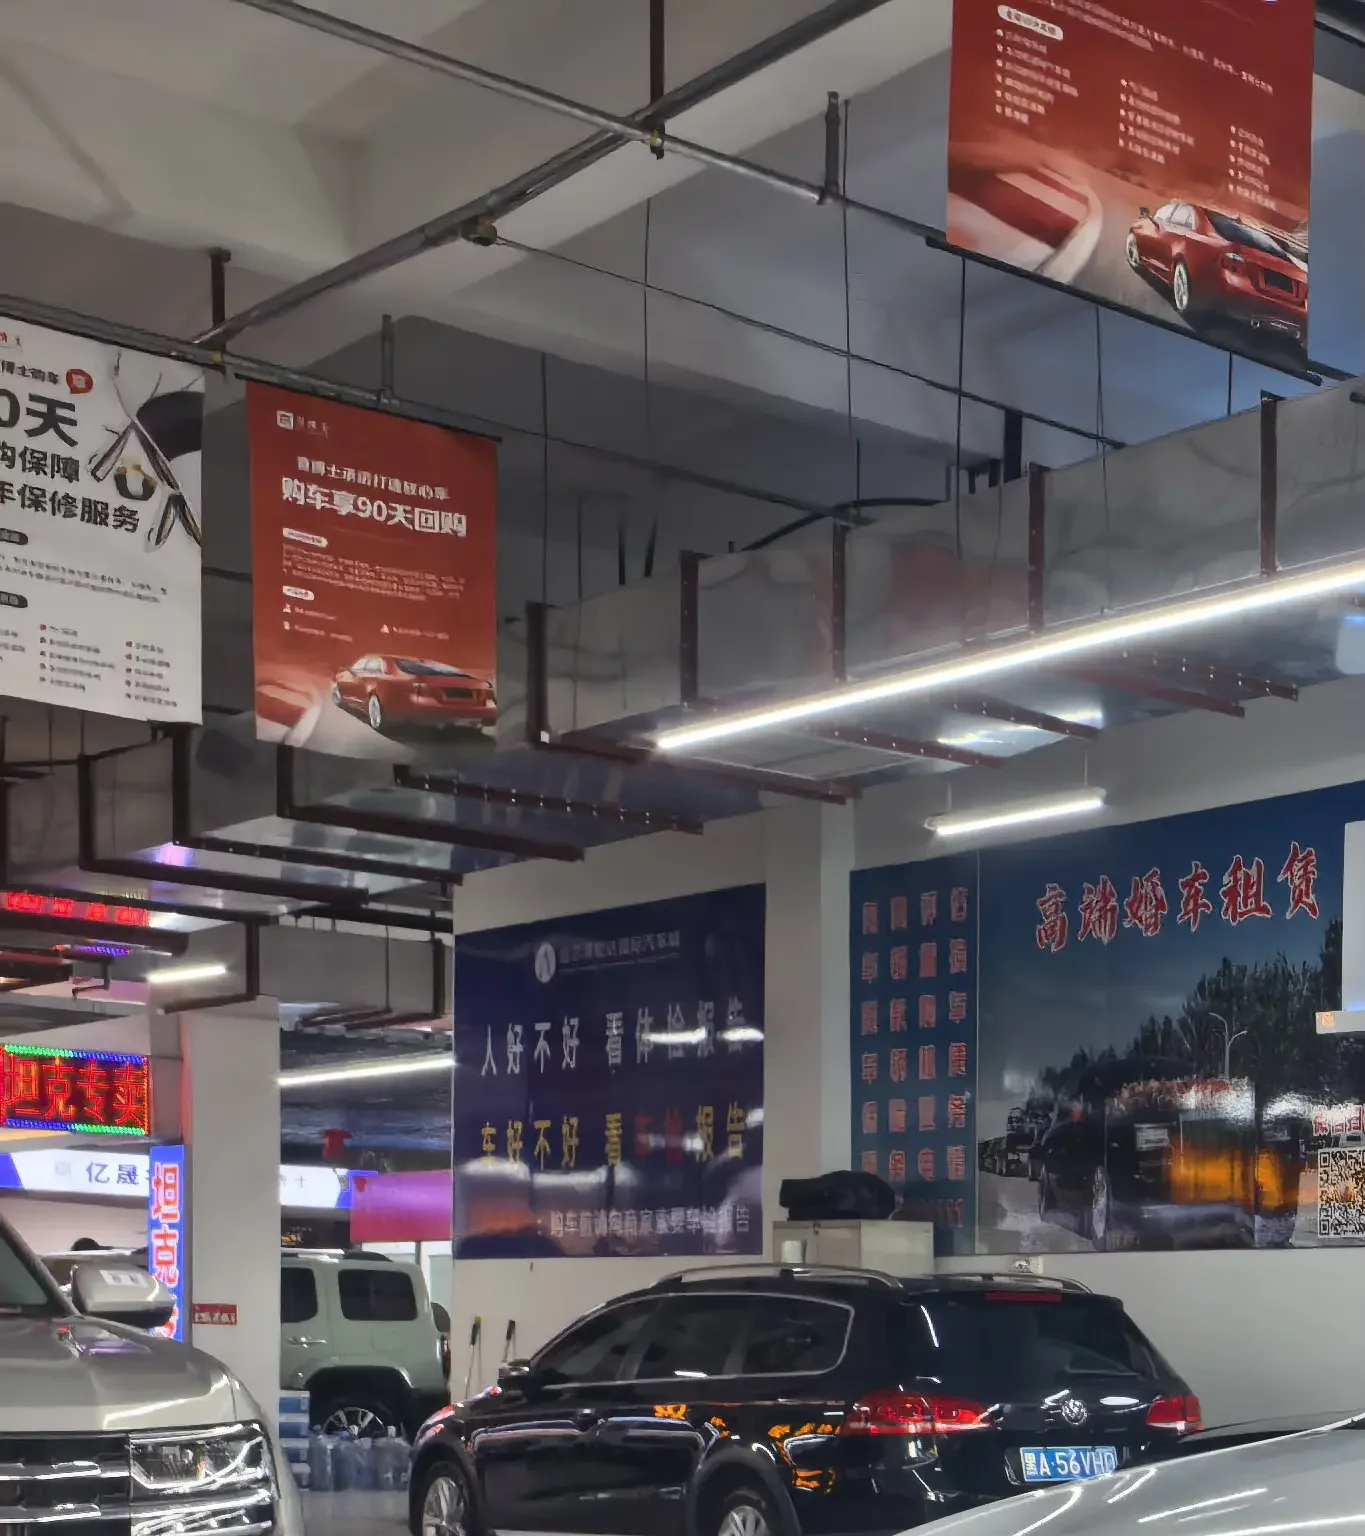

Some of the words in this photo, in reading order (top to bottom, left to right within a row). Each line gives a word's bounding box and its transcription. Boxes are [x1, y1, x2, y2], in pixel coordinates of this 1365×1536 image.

[282, 477, 468, 537] 购车享90天回购
[1035, 841, 1320, 953] 高端婚车租赁
[481, 1015, 580, 1076] 人好不好
[2, 1053, 147, 1126] 坦克专卖
[86, 1161, 150, 1186] 亿晟
[481, 1114, 580, 1174] 车好不好
